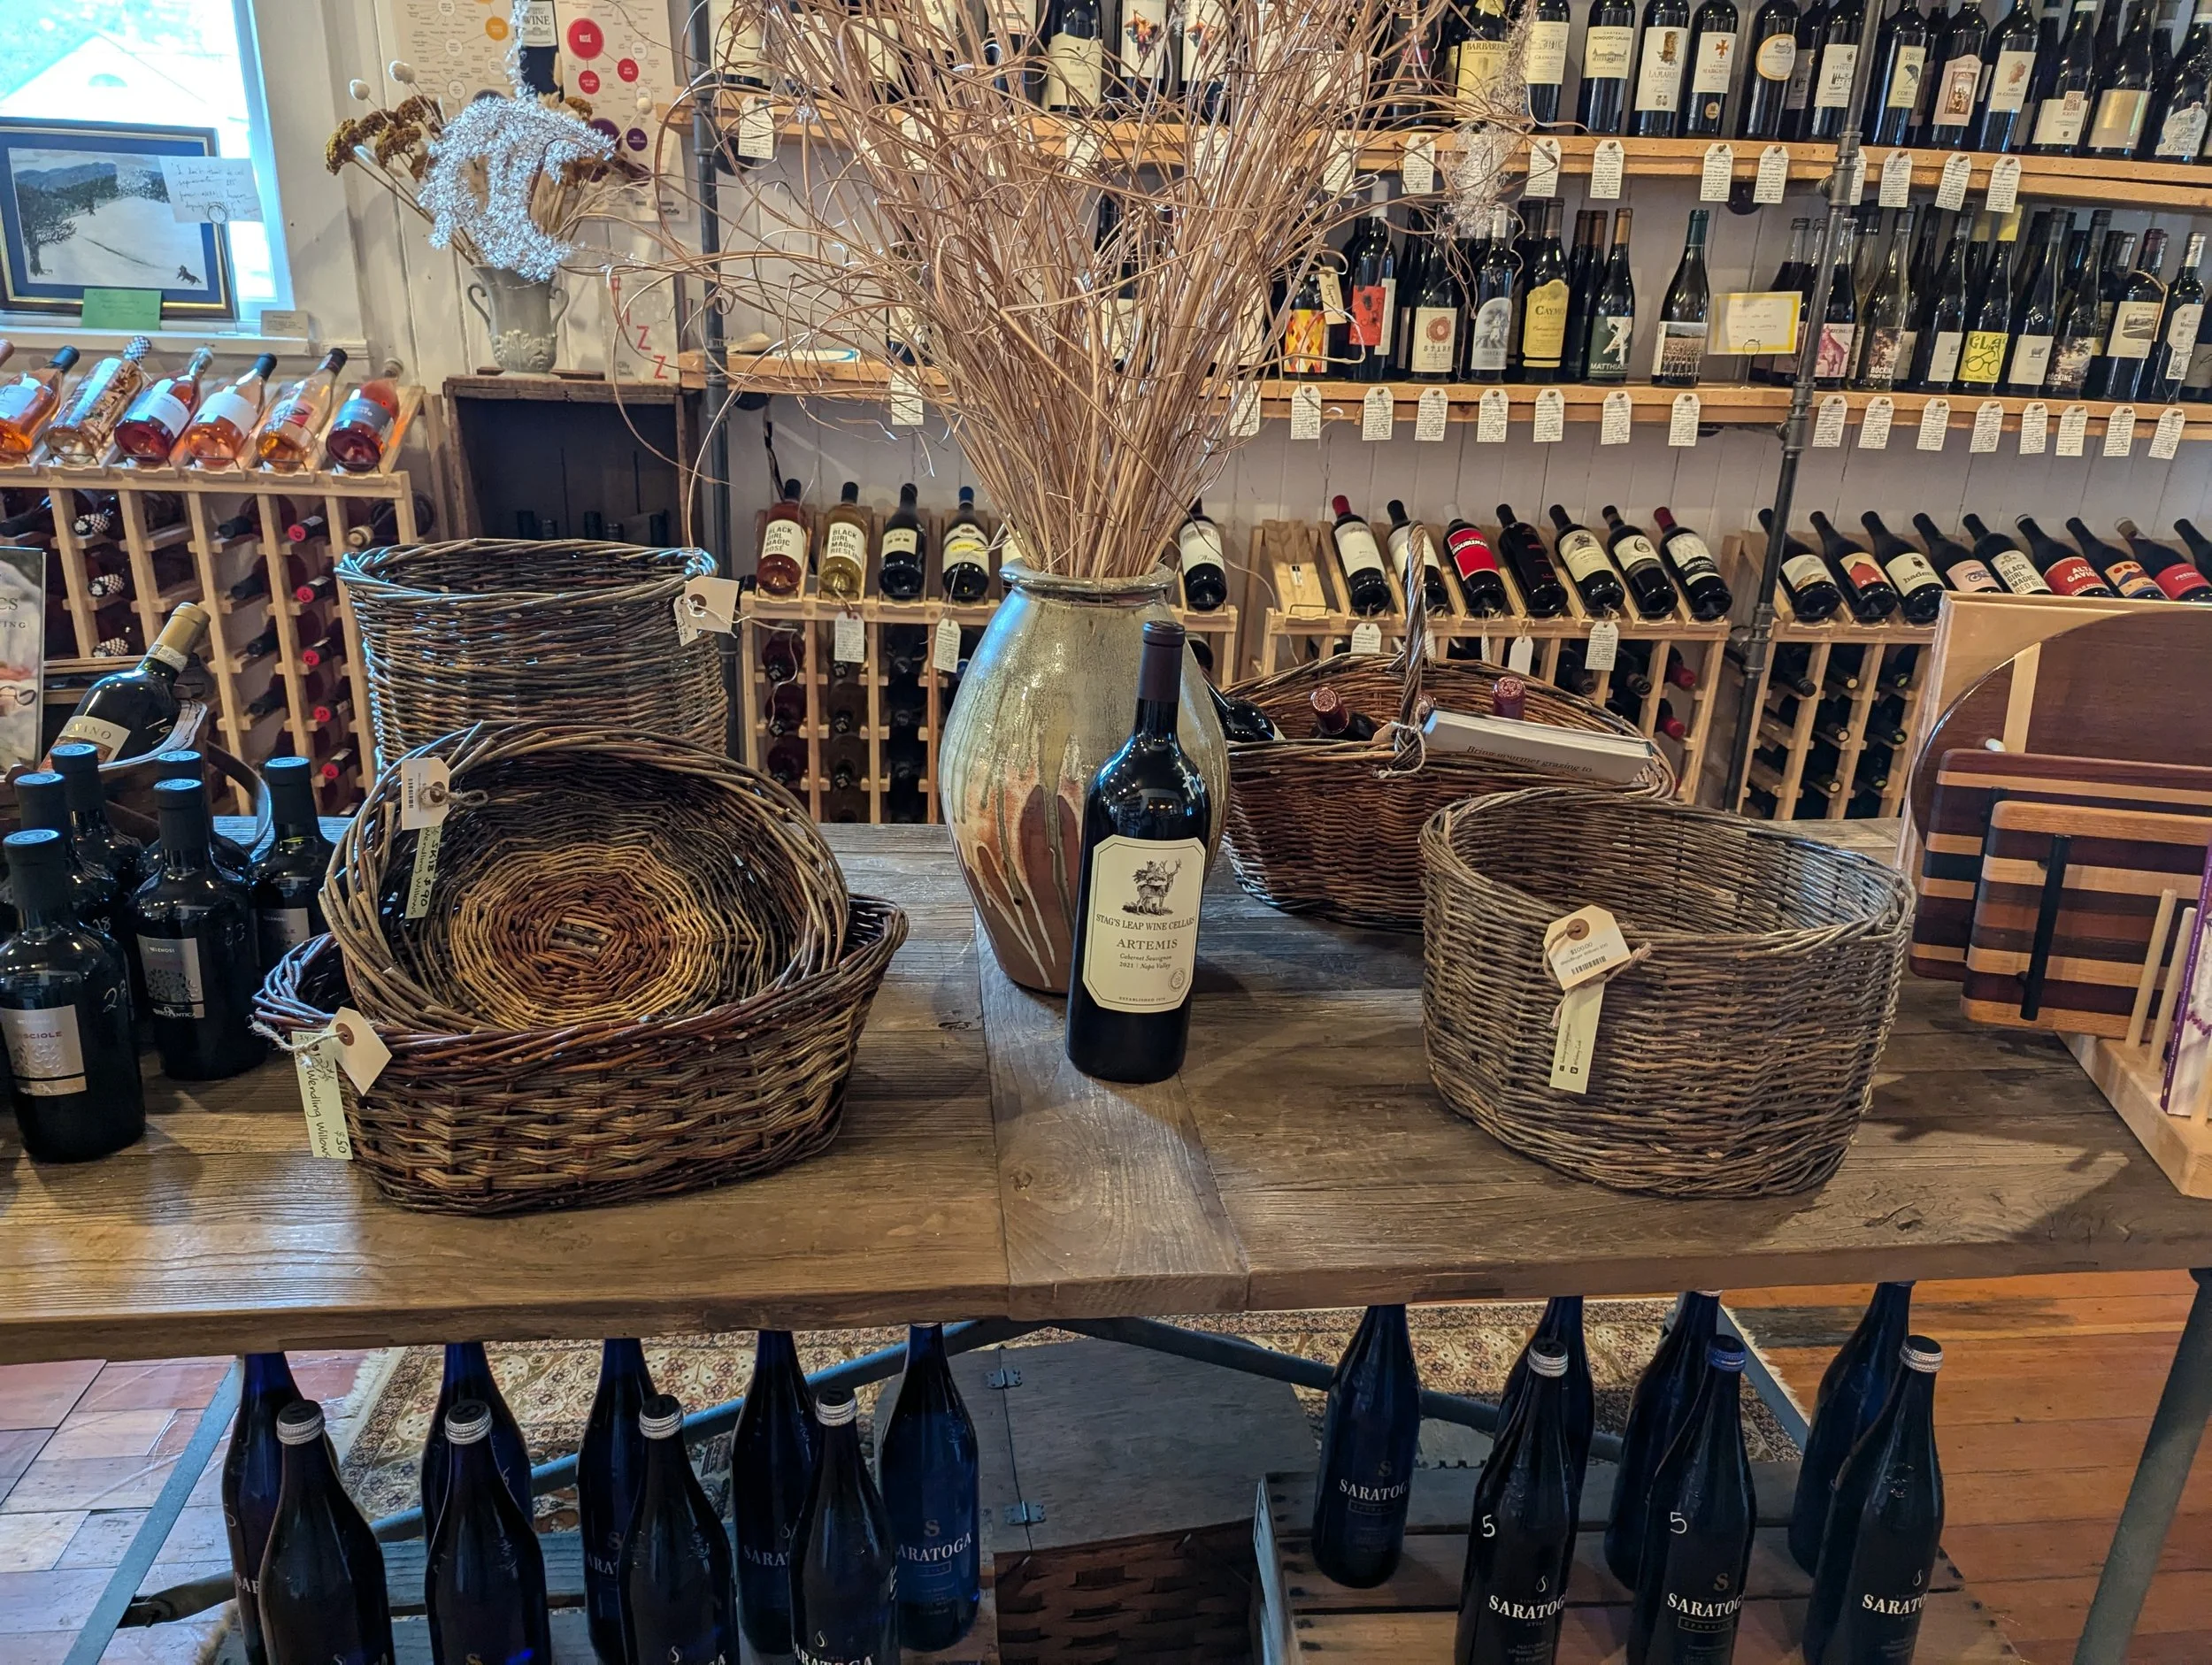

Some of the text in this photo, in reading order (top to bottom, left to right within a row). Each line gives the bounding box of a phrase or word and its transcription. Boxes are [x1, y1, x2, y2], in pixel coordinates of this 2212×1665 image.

[832, 541, 856, 551] MAGIC
[833, 529, 857, 540] BLACK
[2003, 564, 2027, 578] BLACK
[2007, 572, 2024, 582] GIRL
[2011, 575, 2036, 588] MAGIC
[1467, 746, 1495, 756] Bring
[1540, 760, 1580, 772] grazing
[410, 878, 423, 916] Willows
[1096, 914, 1195, 931] STAG'S LEAP WINE CELLARS
[1117, 939, 1178, 950] ARTEMIS
[1119, 953, 1144, 962] Cabernet
[306, 1070, 322, 1118] Wendling
[315, 1122, 332, 1160] Willows
[334, 1131, 349, 1154] $50
[1482, 1515, 1496, 1538] 5
[1671, 1511, 1687, 1534] 5
[897, 1531, 972, 1561] ARATOGA
[1488, 1593, 1568, 1620] SARATOG
[1667, 1592, 1743, 1617] SARATOG
[1862, 1592, 1926, 1615] SARATO
